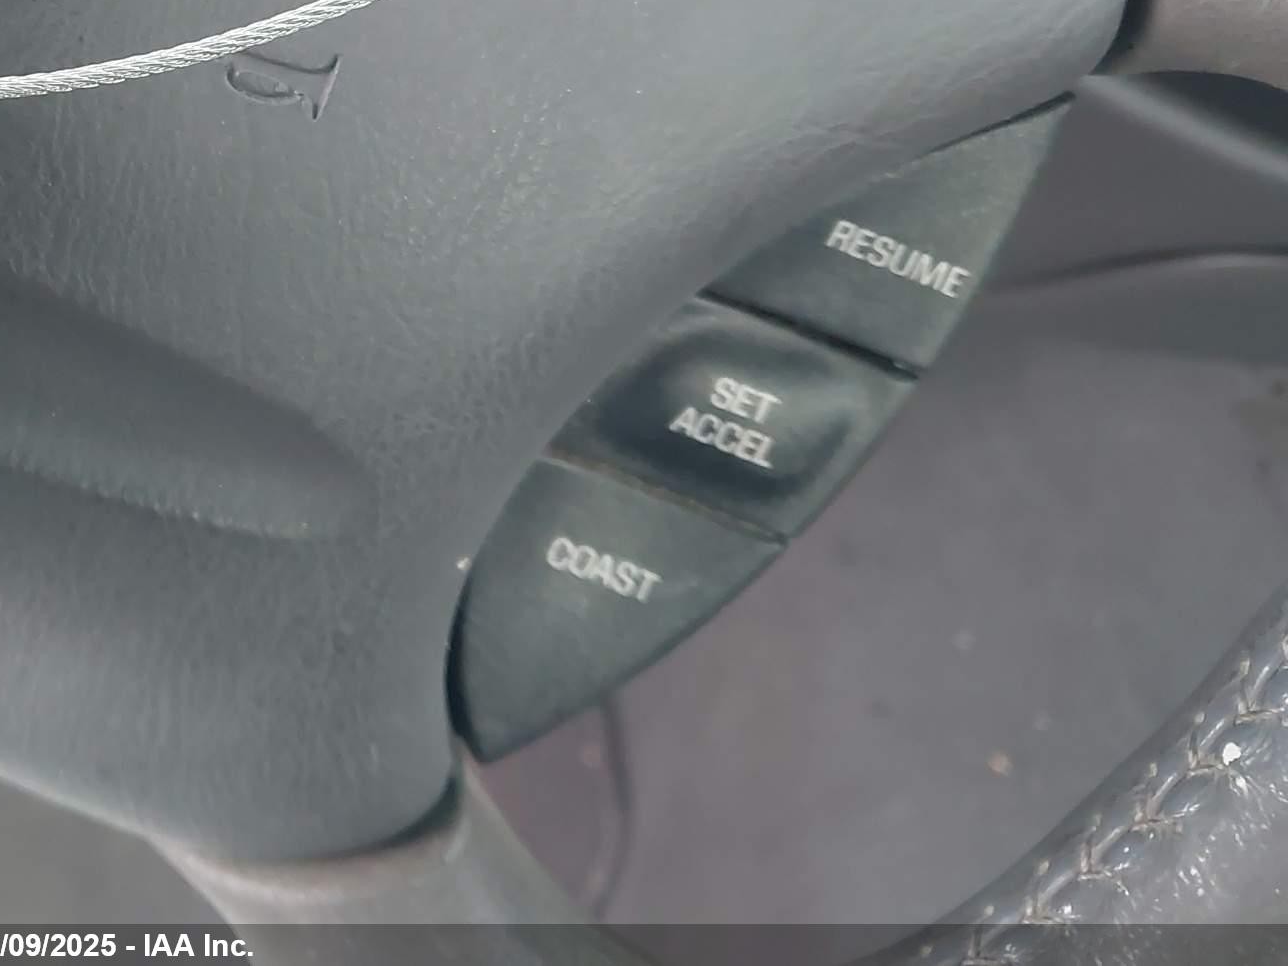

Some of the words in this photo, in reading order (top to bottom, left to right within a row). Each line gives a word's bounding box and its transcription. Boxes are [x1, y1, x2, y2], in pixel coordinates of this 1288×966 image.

[825, 219, 972, 298] RESUME
[710, 376, 782, 425] SET
[669, 406, 773, 469] ACCEL
[544, 536, 662, 603] COAST
